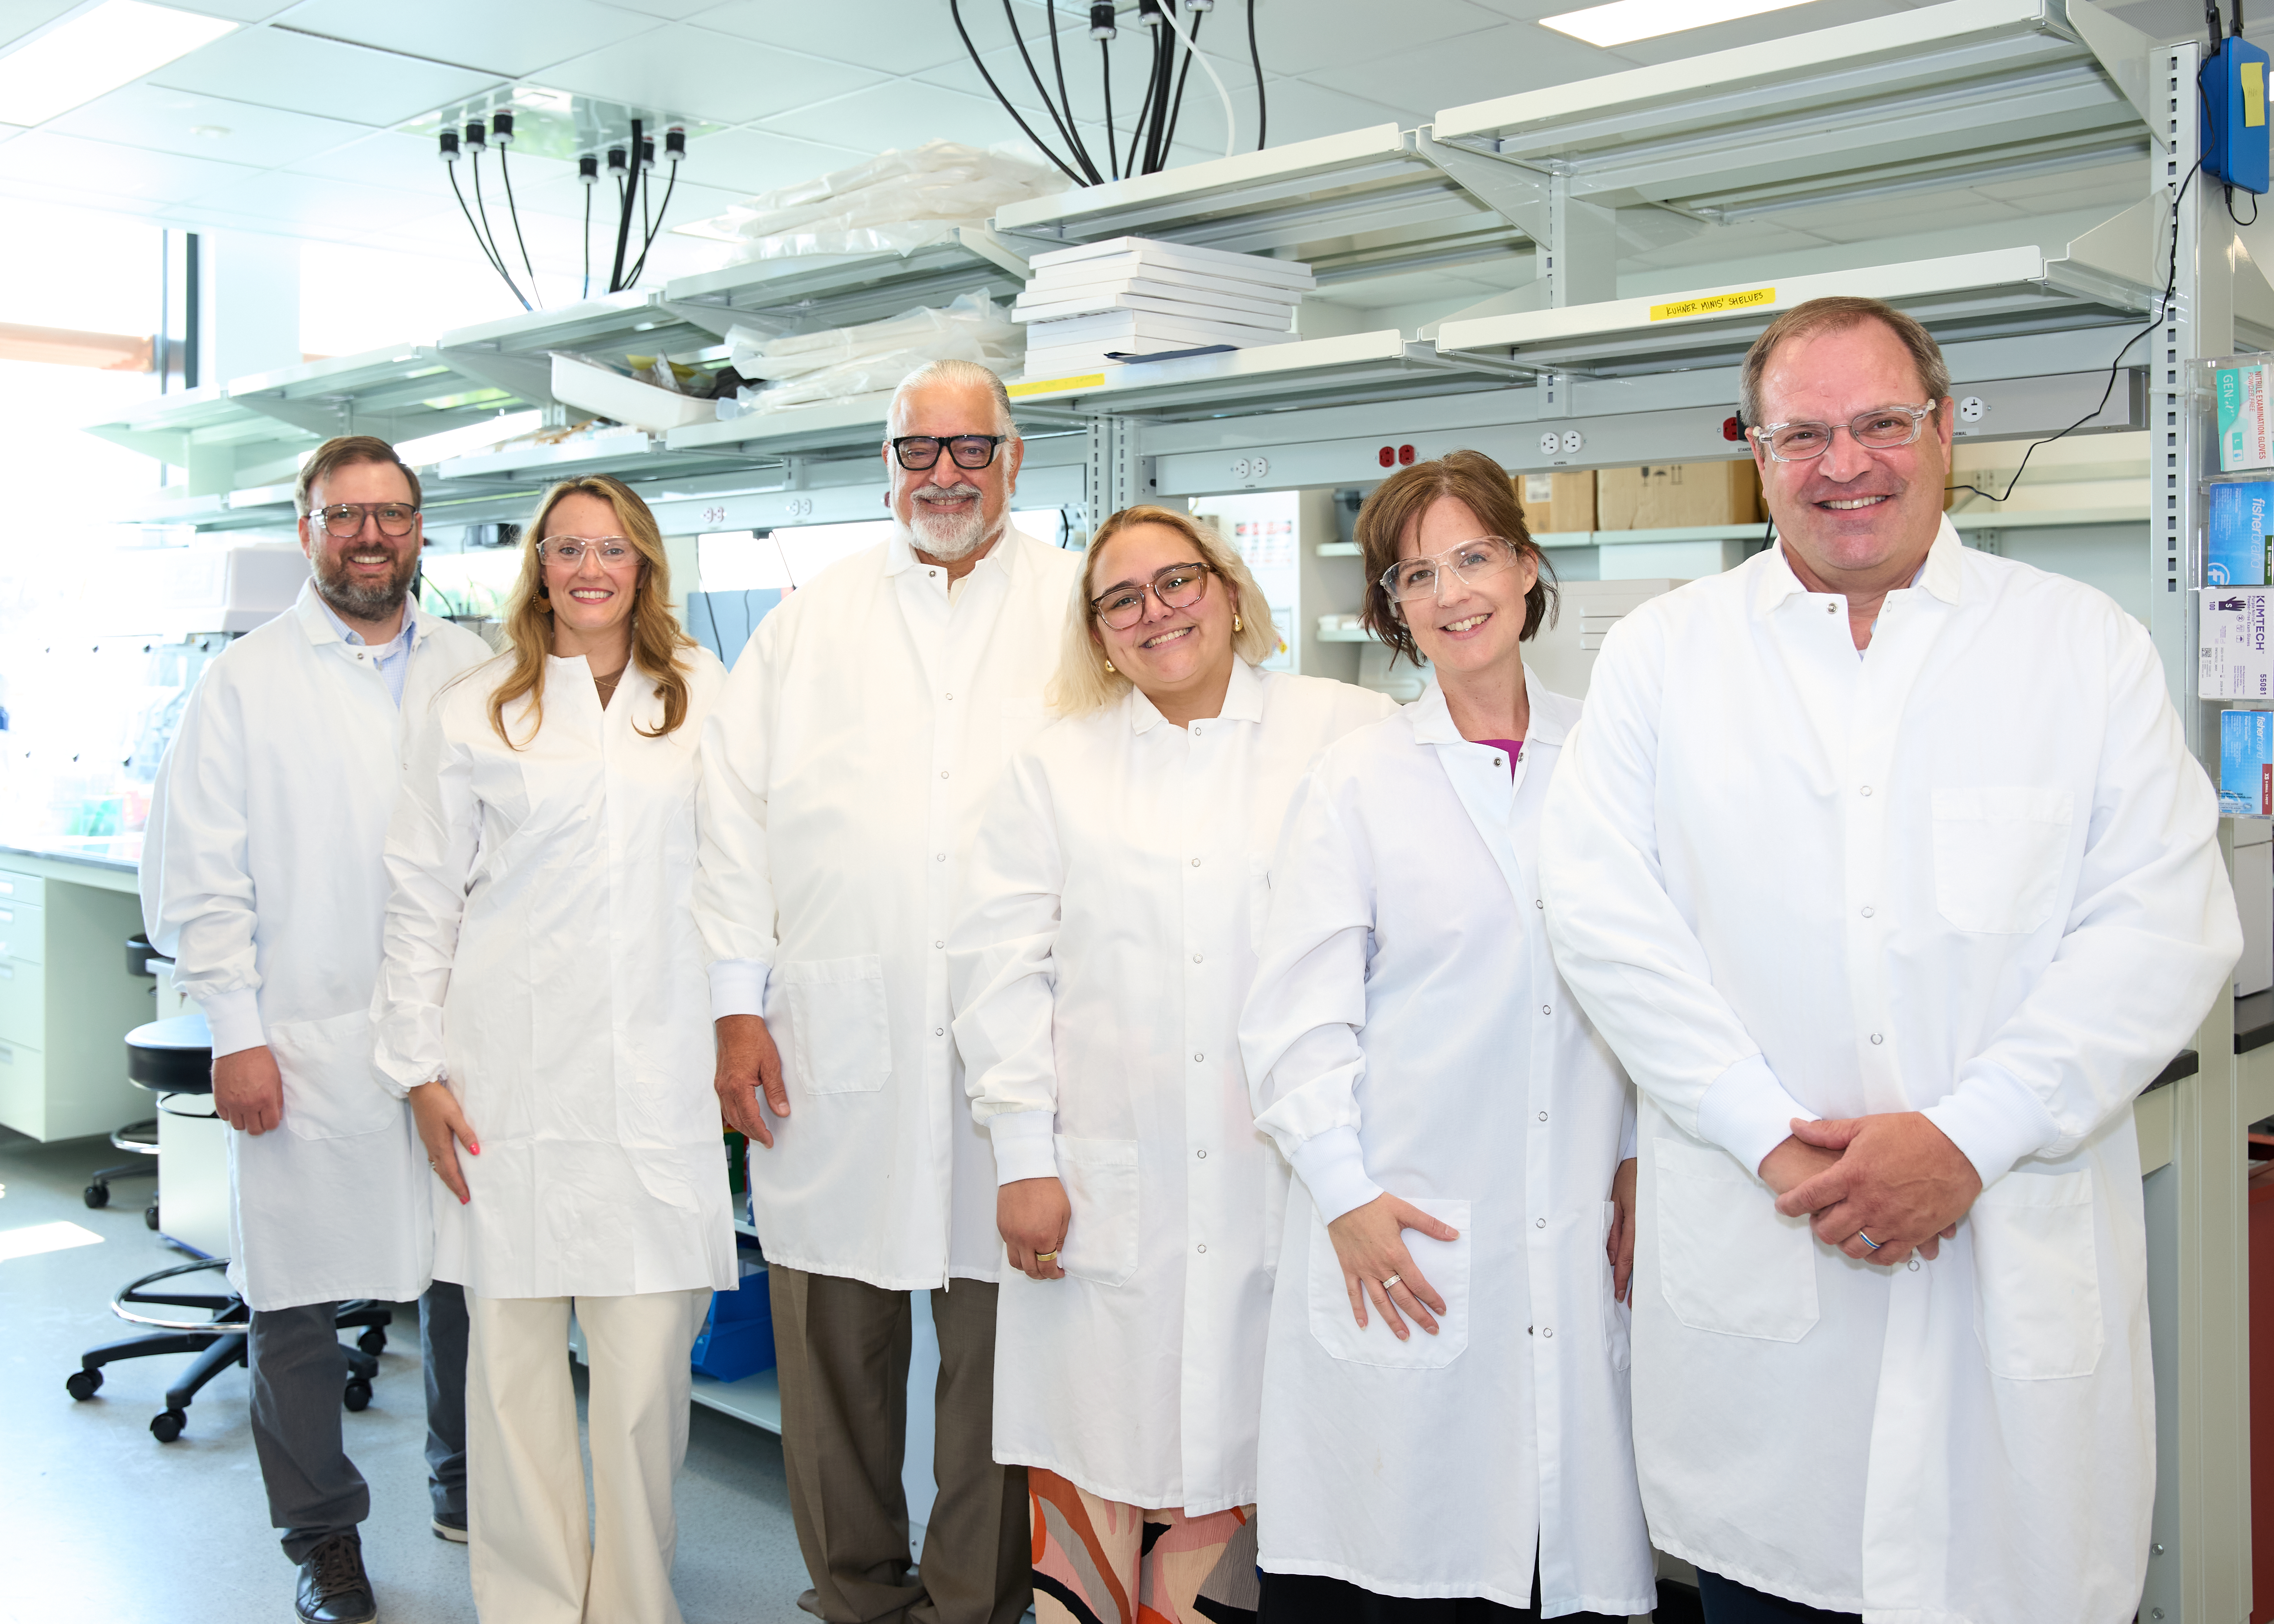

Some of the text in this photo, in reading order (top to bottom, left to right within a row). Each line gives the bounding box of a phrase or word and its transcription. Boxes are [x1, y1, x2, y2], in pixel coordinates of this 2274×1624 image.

[1666, 292, 1763, 317] KUHNER MINIS' SHELVES
[2256, 395, 2264, 435] EXAMINATION
[2251, 498, 2265, 569] fisherbrand
[2256, 716, 2265, 759] fisherbrand
